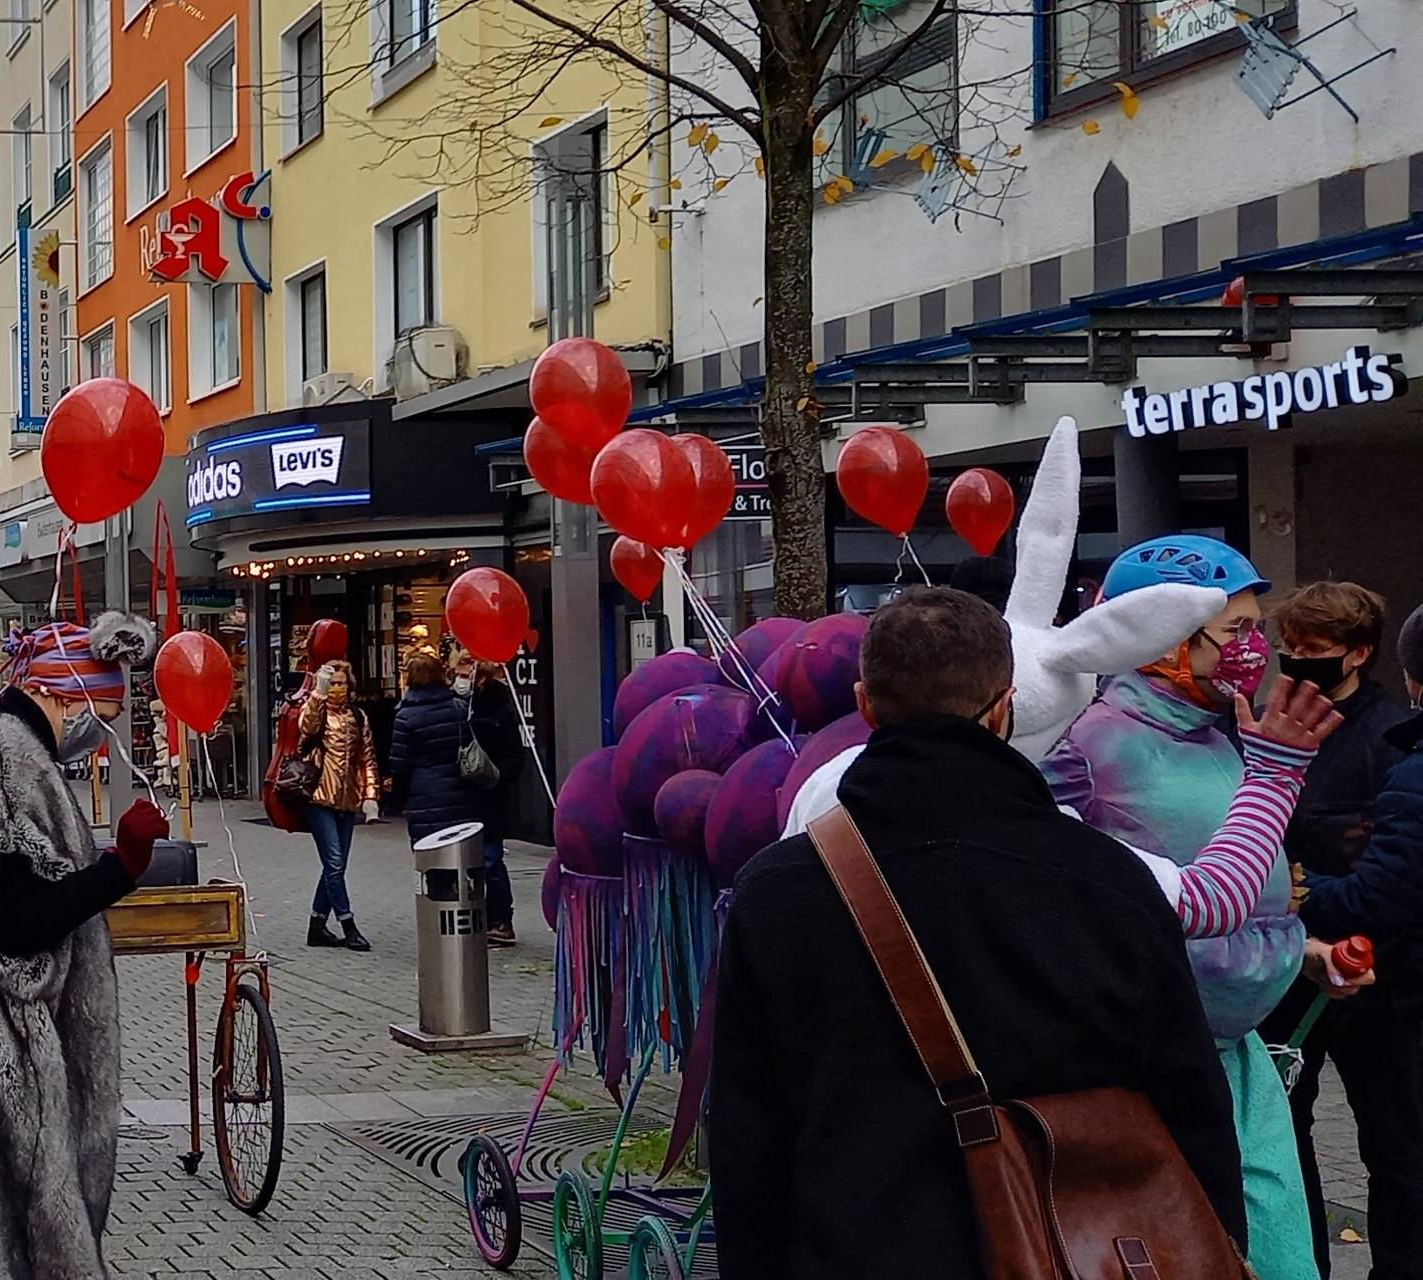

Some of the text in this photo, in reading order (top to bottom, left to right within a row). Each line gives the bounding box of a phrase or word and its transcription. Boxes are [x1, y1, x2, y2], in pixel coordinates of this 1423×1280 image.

[727, 453, 766, 480] Flo
[188, 455, 243, 508] adidas
[735, 494, 771, 511] & Tre
[636, 633, 653, 648] 11a
